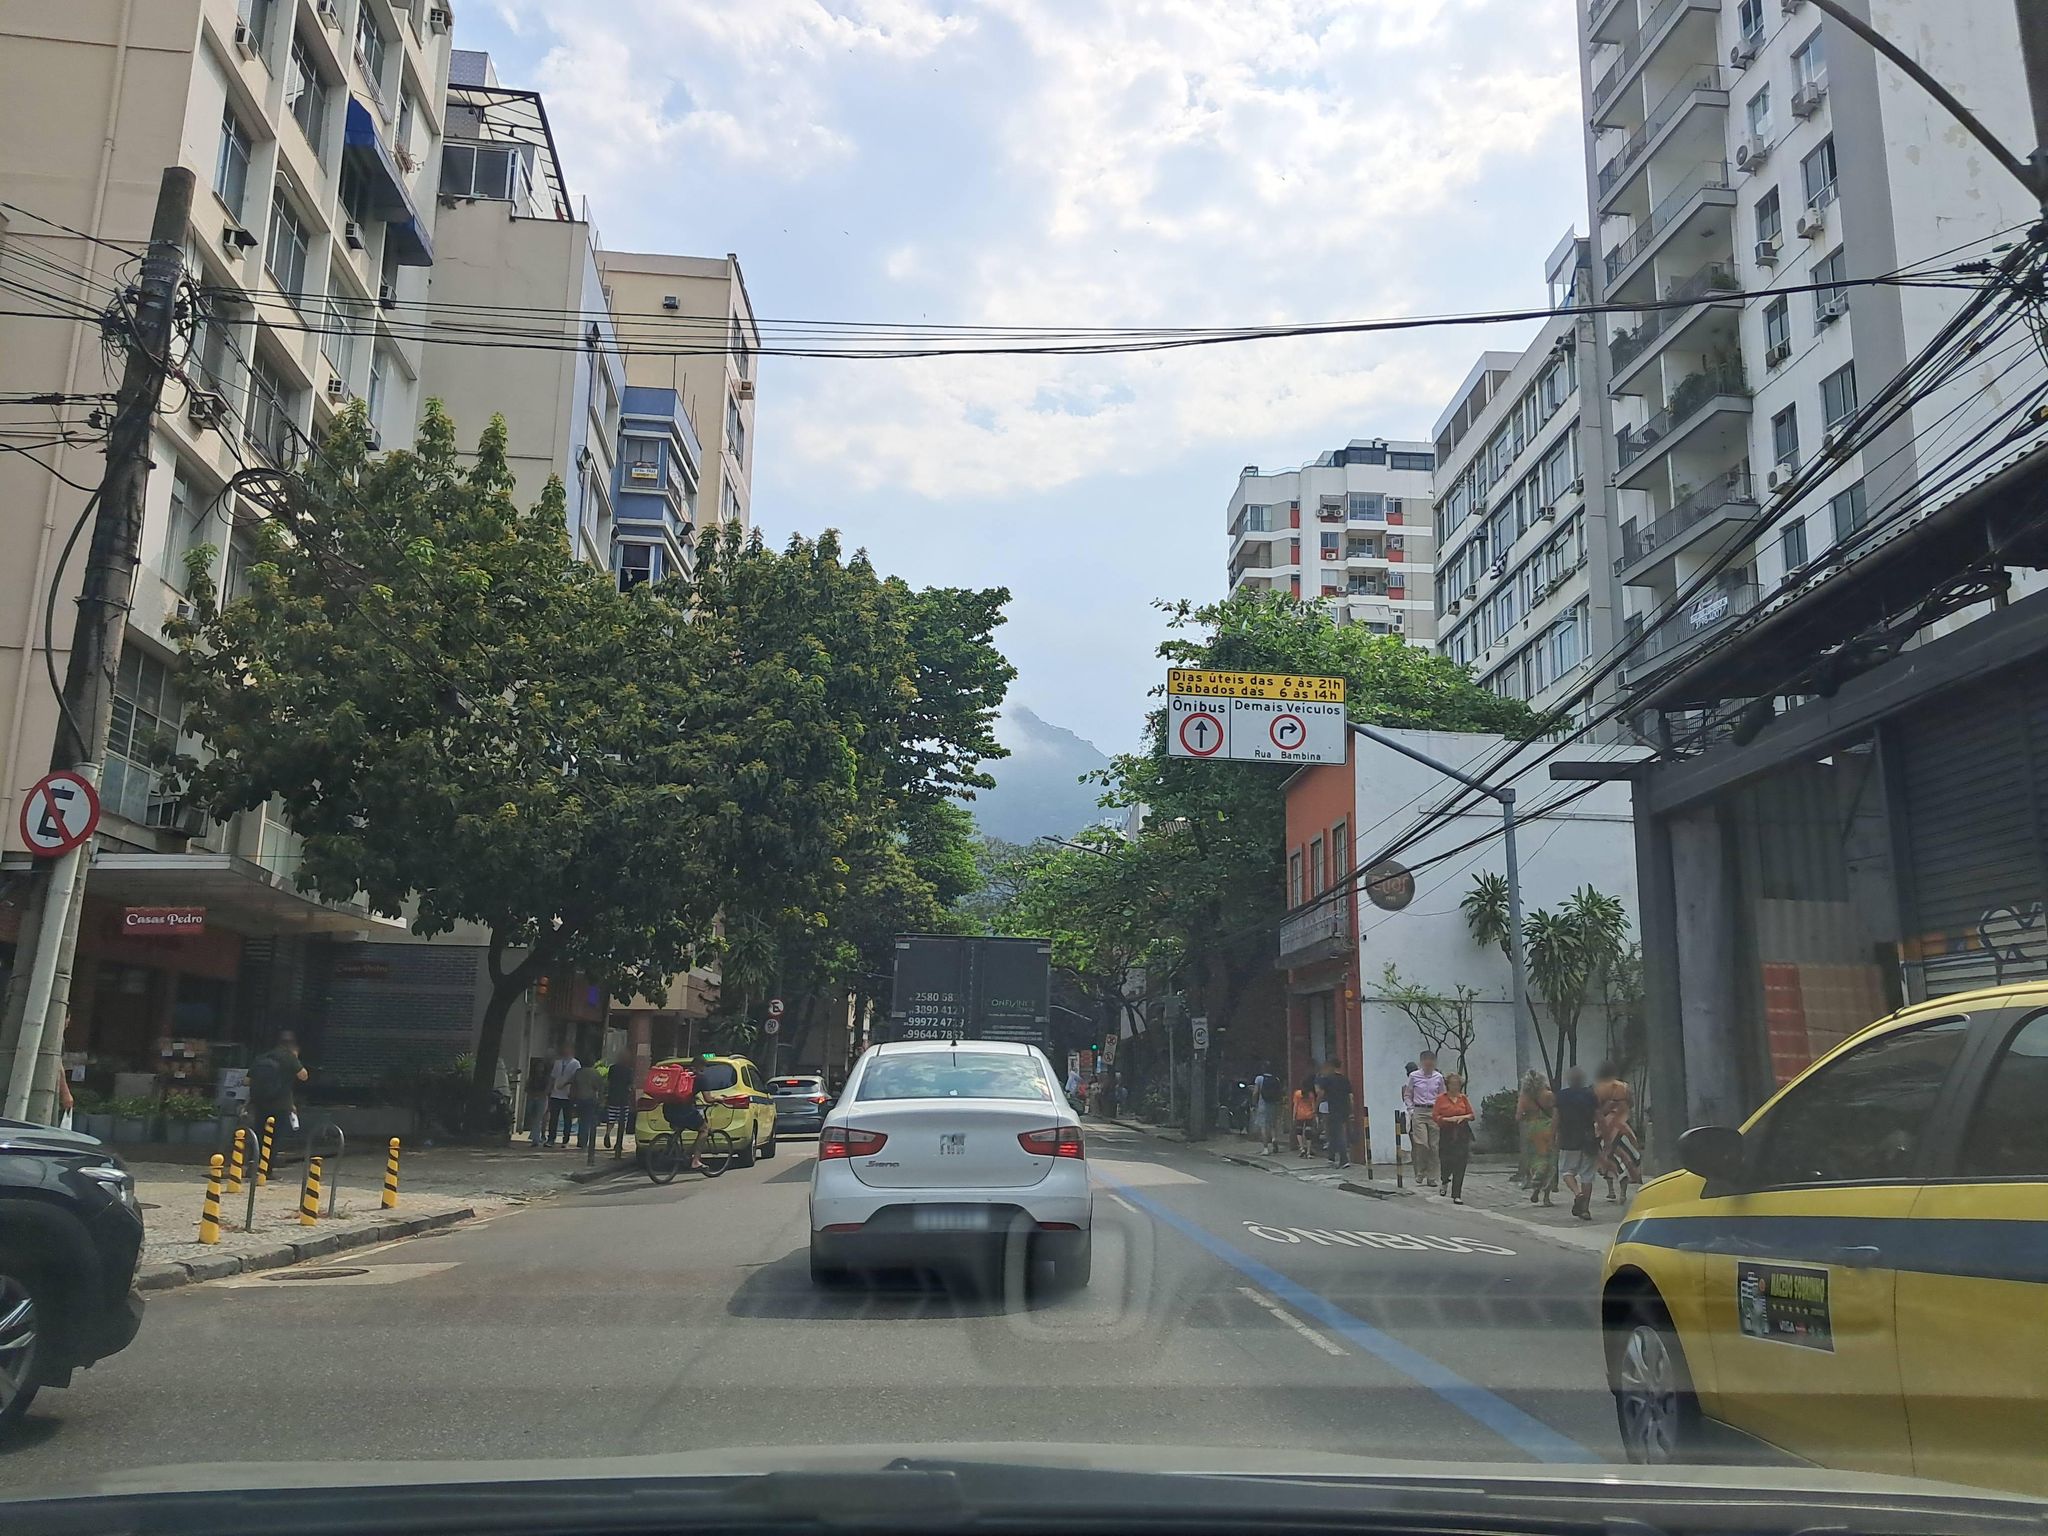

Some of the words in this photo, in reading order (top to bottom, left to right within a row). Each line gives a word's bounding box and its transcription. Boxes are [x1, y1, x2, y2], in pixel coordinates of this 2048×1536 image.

[1172, 671, 1203, 683] Dias
[1209, 673, 1245, 685] úteis
[1250, 675, 1274, 686] das
[1283, 677, 1292, 687] 6
[1297, 675, 1313, 689] às
[1318, 679, 1341, 690] 21h
[1176, 682, 1236, 695] Sábados
[1241, 685, 1265, 697] das
[1279, 688, 1288, 698] 6
[1293, 687, 1309, 699] às
[1314, 690, 1338, 700] 14h
[1172, 696, 1226, 713] Ônibus
[1234, 700, 1283, 713] Demais
[1254, 749, 1272, 759] Rua
[1281, 751, 1321, 761] Bambina
[126, 913, 165, 926] Casas
[167, 913, 203, 926] Pedro
[915, 992, 939, 1002] 2580
[908, 1017, 939, 1027] 99972
[907, 1029, 938, 1039] 99644
[865, 1160, 900, 1168] Siena
